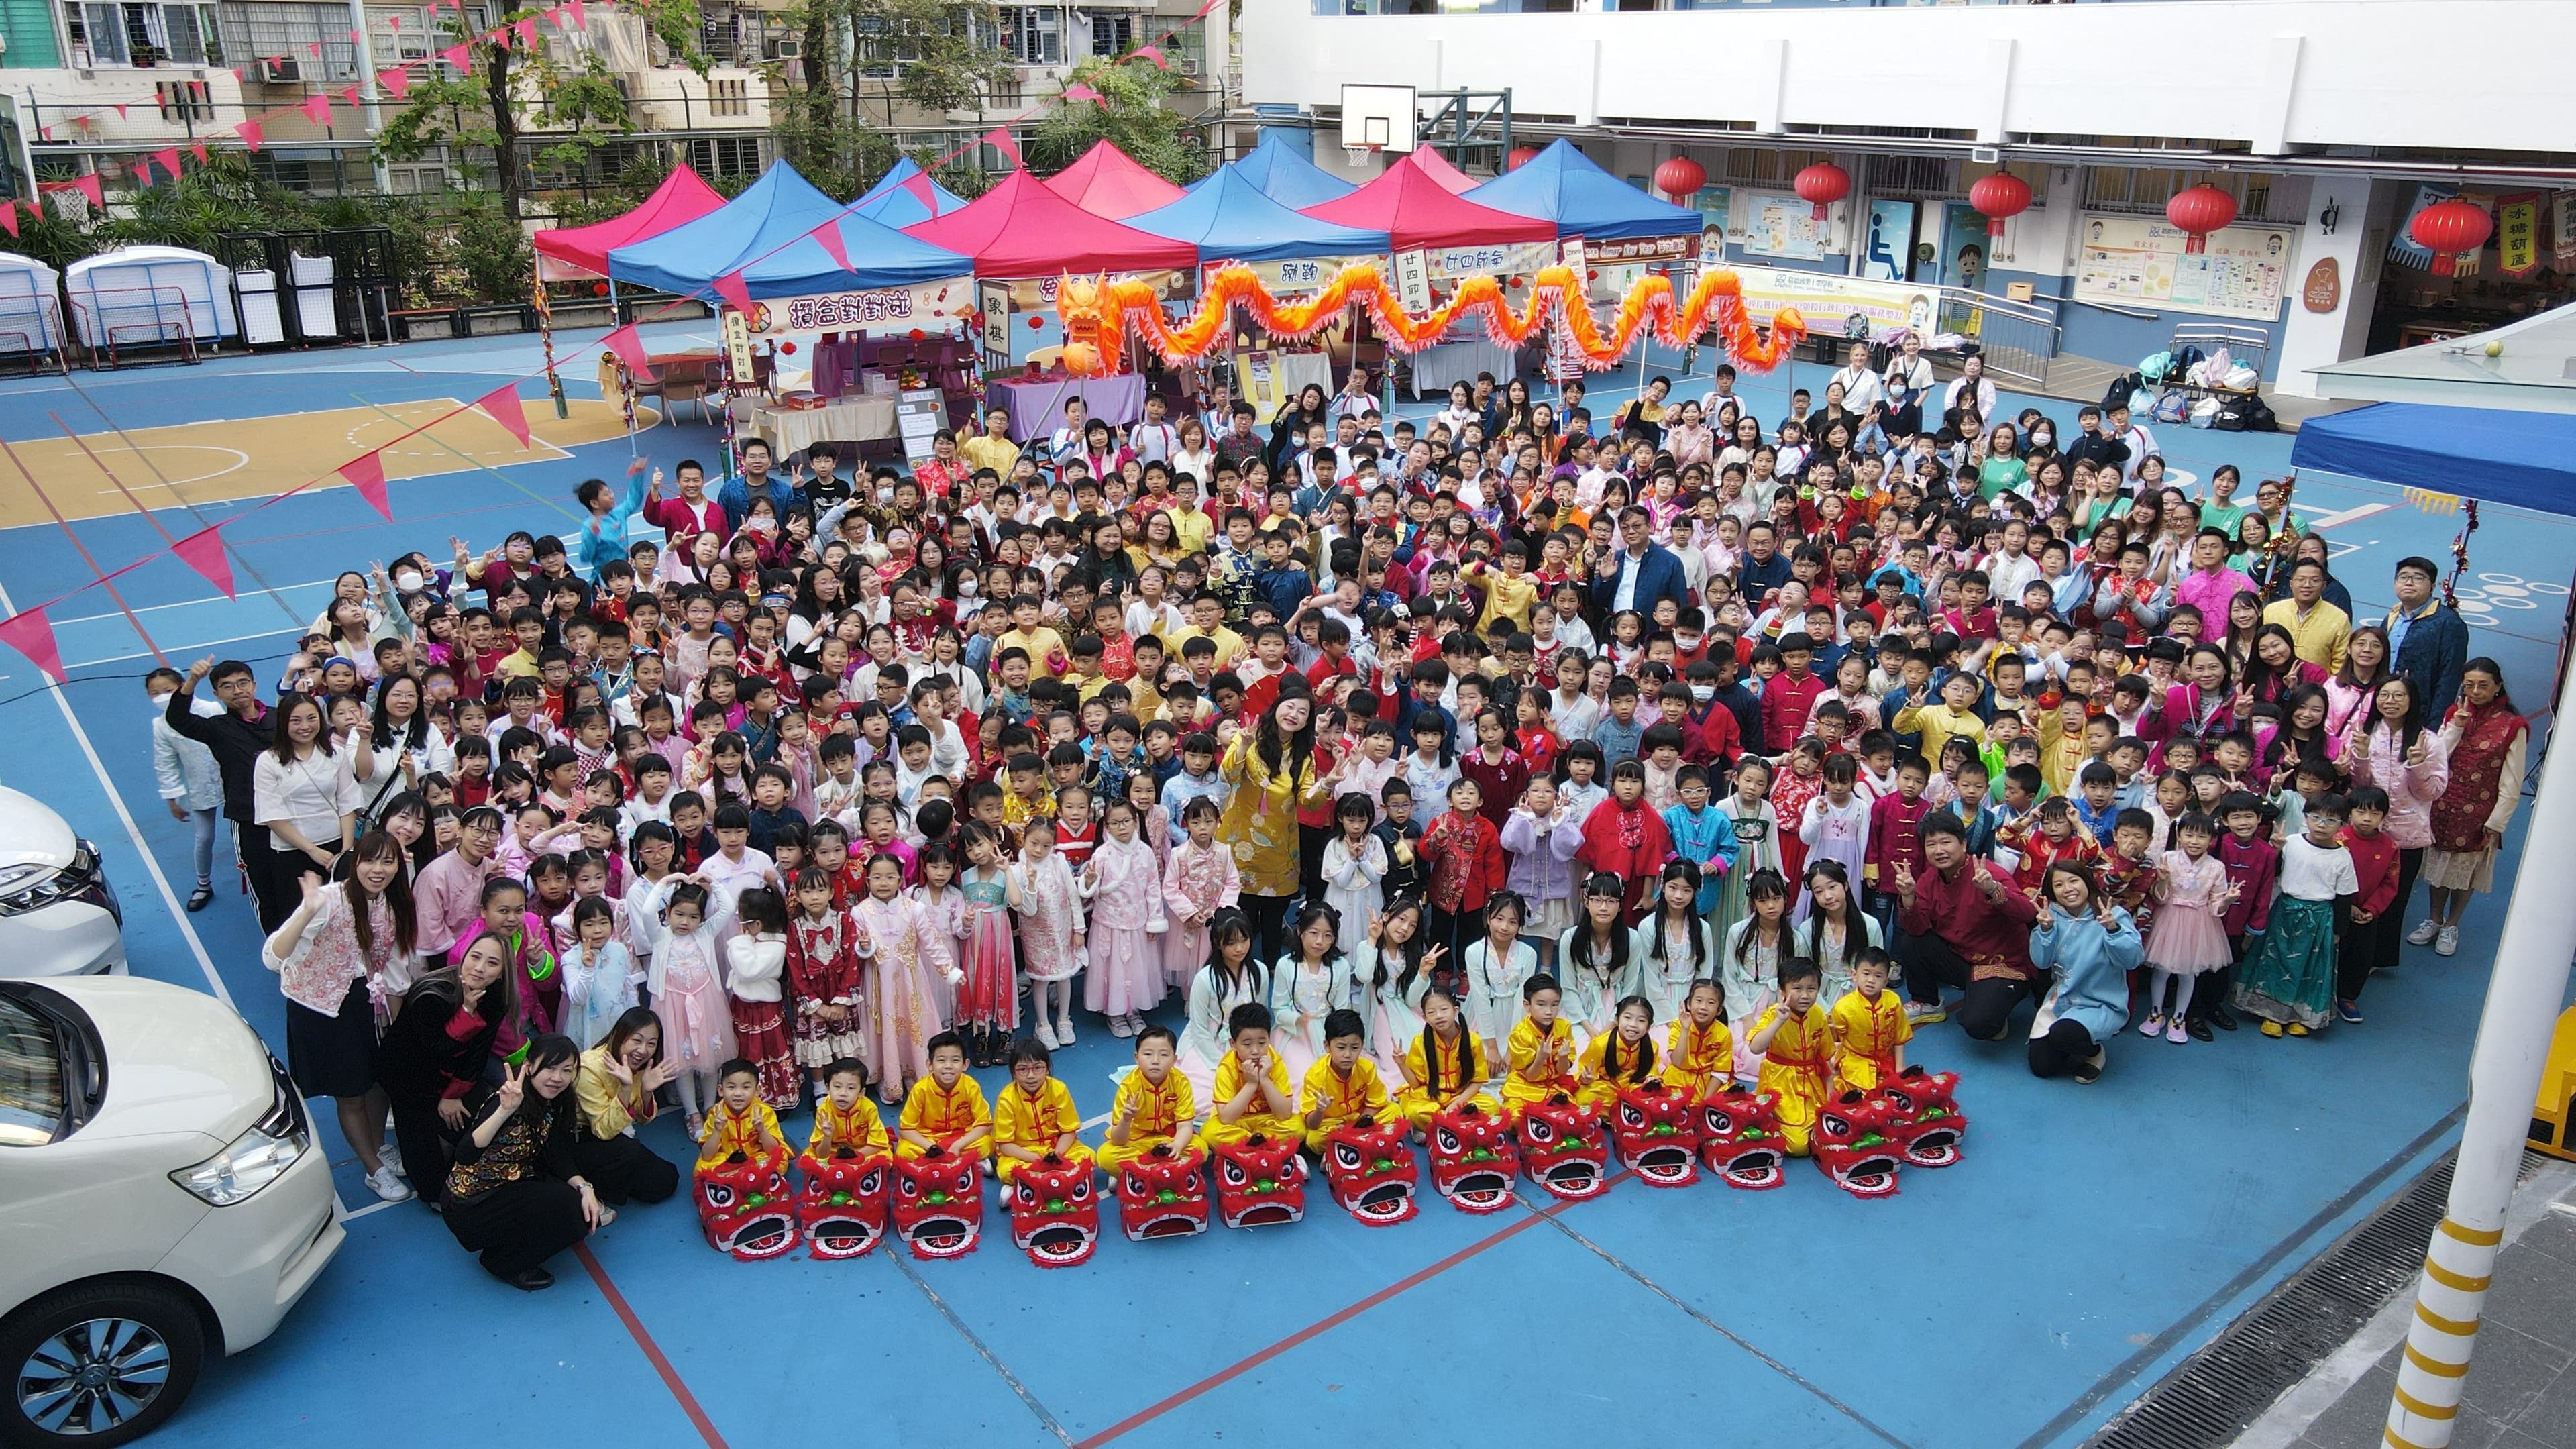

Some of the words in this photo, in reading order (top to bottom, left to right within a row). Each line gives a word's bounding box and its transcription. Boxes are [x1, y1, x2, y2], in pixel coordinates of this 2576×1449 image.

[2508, 207, 2528, 266] 冰糖葫蘆
[1281, 262, 1318, 282] 蹴鞠
[1445, 250, 1504, 271] 廿四節氣
[987, 297, 1004, 343] 象棋
